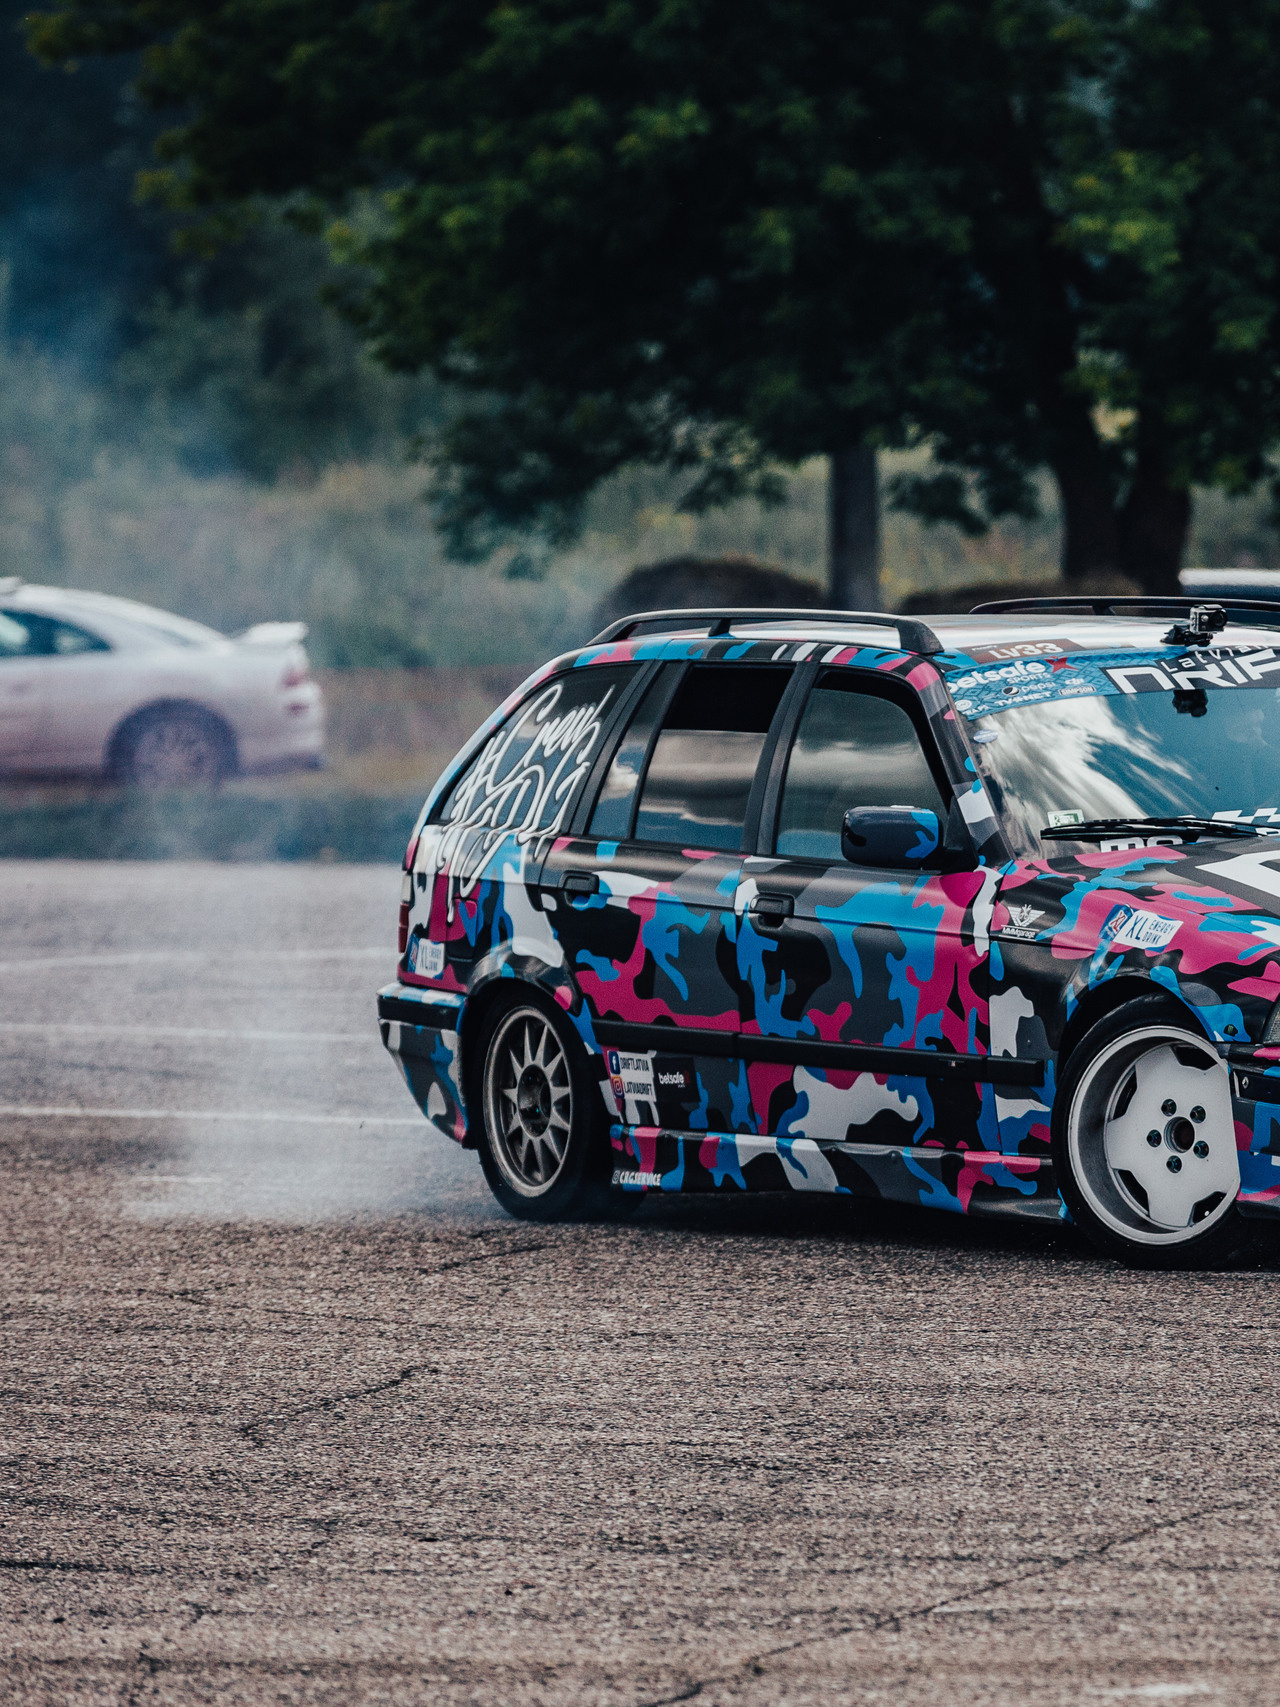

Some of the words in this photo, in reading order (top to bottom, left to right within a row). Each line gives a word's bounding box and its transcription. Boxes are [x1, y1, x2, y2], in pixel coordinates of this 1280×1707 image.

[988, 643, 1064, 659] LV33
[1021, 682, 1056, 694] pepsi
[1126, 915, 1148, 940] XL
[1149, 919, 1176, 934] ENERGY
[1142, 931, 1161, 945] DRINK
[658, 1071, 684, 1085] betsafe
